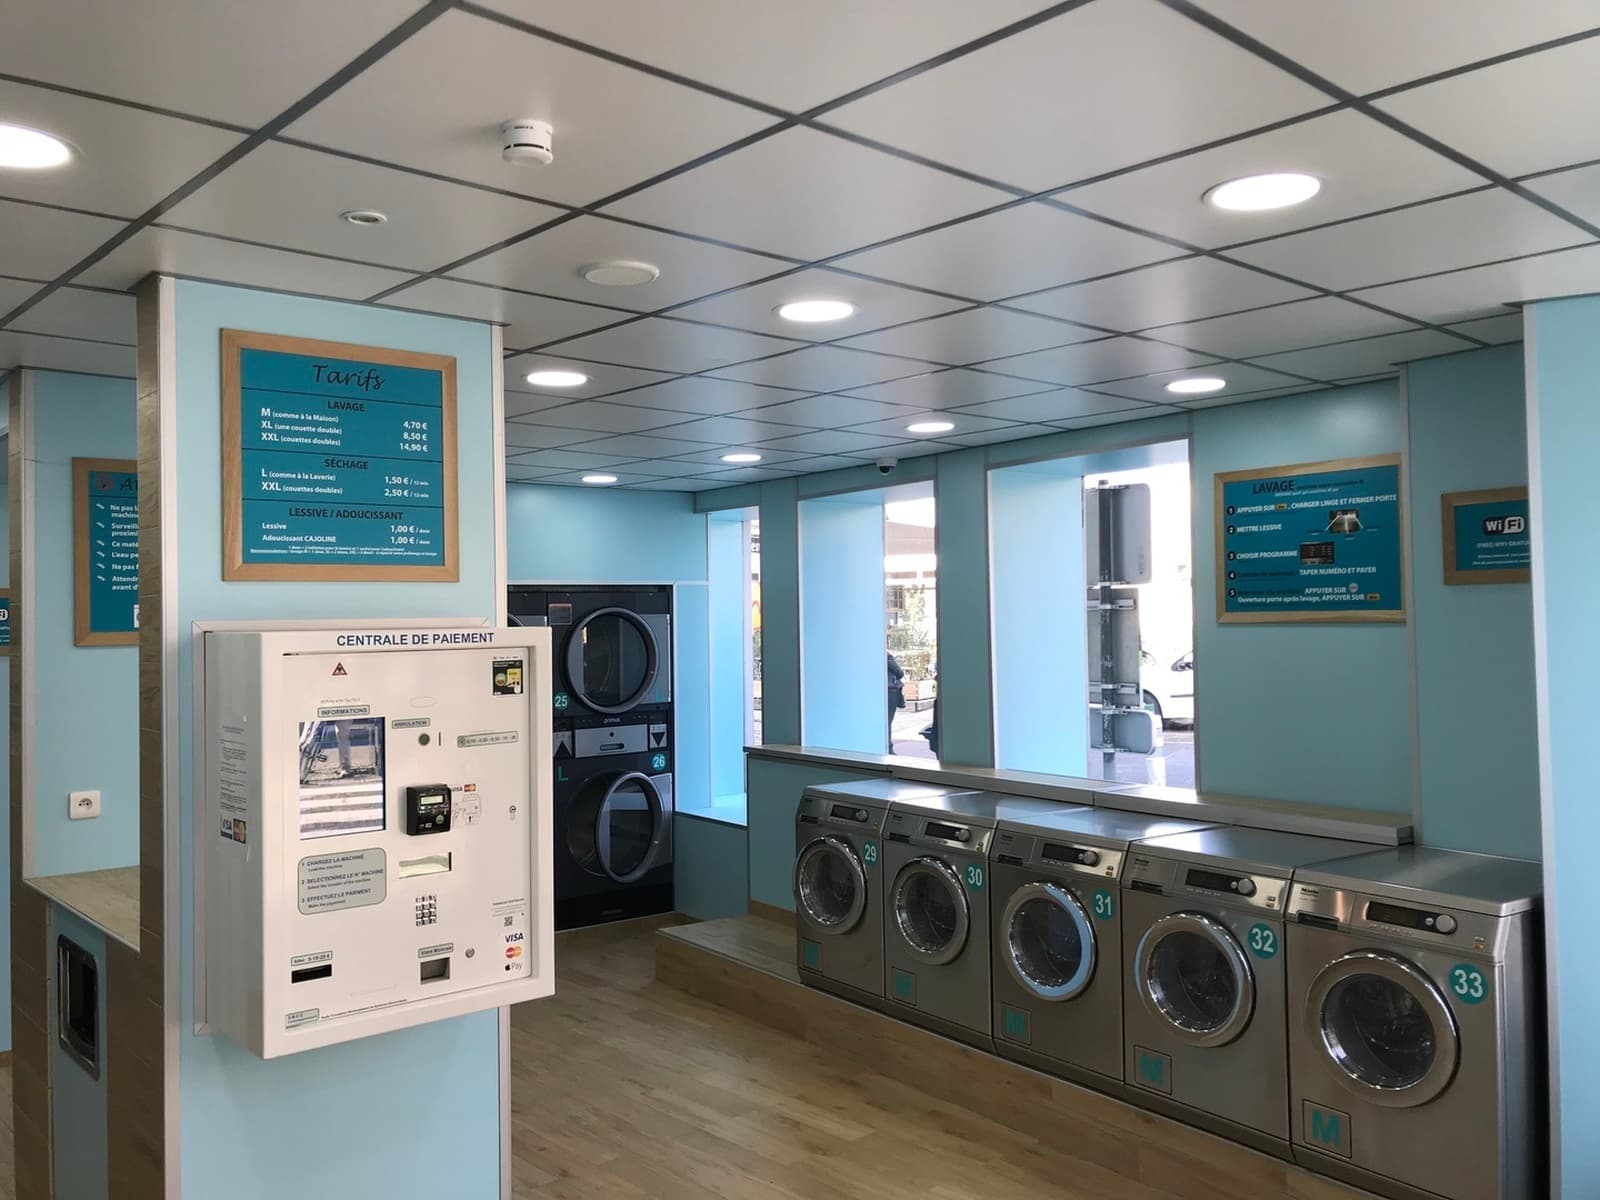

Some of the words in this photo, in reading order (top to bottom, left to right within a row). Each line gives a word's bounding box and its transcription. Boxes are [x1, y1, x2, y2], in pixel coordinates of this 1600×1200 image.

[312, 364, 386, 391] Tarifs
[328, 401, 365, 412] LAVAGE
[261, 408, 270, 416] M
[272, 411, 299, 420] (comme
[313, 414, 338, 422] Maison)
[402, 421, 420, 430] 4,70
[261, 420, 272, 429] XL
[274, 423, 290, 431] (une
[291, 424, 316, 432] couette
[317, 426, 342, 435] double)
[403, 432, 420, 440] 8,50
[261, 432, 279, 442] XXL
[280, 435, 311, 444] (couettes
[312, 438, 340, 446] doubles)
[400, 442, 421, 452] 14,90
[324, 458, 368, 470] SÉCHAGE
[262, 468, 267, 477] L
[310, 474, 336, 482] Laverie)
[384, 476, 402, 485] 1,50
[262, 481, 281, 491] XXL
[283, 485, 313, 493] (couettes
[315, 486, 342, 495] doubles)
[384, 488, 402, 498] 2,50
[404, 490, 408, 498] €
[1252, 480, 1294, 494] LAVAGE
[289, 508, 328, 518] LESSIVE
[330, 510, 334, 518] /
[336, 510, 403, 520] ADOUCISSANT
[390, 525, 407, 534] 1,00
[304, 535, 336, 543] CAJOLINE
[390, 536, 407, 545] 1,00
[336, 634, 408, 646] CENTRALE
[412, 634, 428, 645] DE
[432, 632, 494, 644] PAIEMENT
[555, 696, 568, 708] 25
[320, 707, 368, 716] INFORMATIONS
[652, 756, 665, 768] 26
[558, 766, 568, 780] L
[307, 858, 332, 866] CHARGEZ
[341, 854, 364, 862] MACHINE
[865, 844, 876, 862] 29
[361, 868, 384, 876] MACHINE
[968, 866, 982, 886] 30
[307, 894, 337, 902] EFFECTUEZ
[1095, 893, 1112, 916] 31
[505, 932, 524, 942] VISA
[1251, 928, 1274, 952] 32
[512, 962, 522, 970] Pay
[1454, 969, 1484, 998] 33
[1141, 1053, 1164, 1084] M
[1312, 1108, 1340, 1148] M
